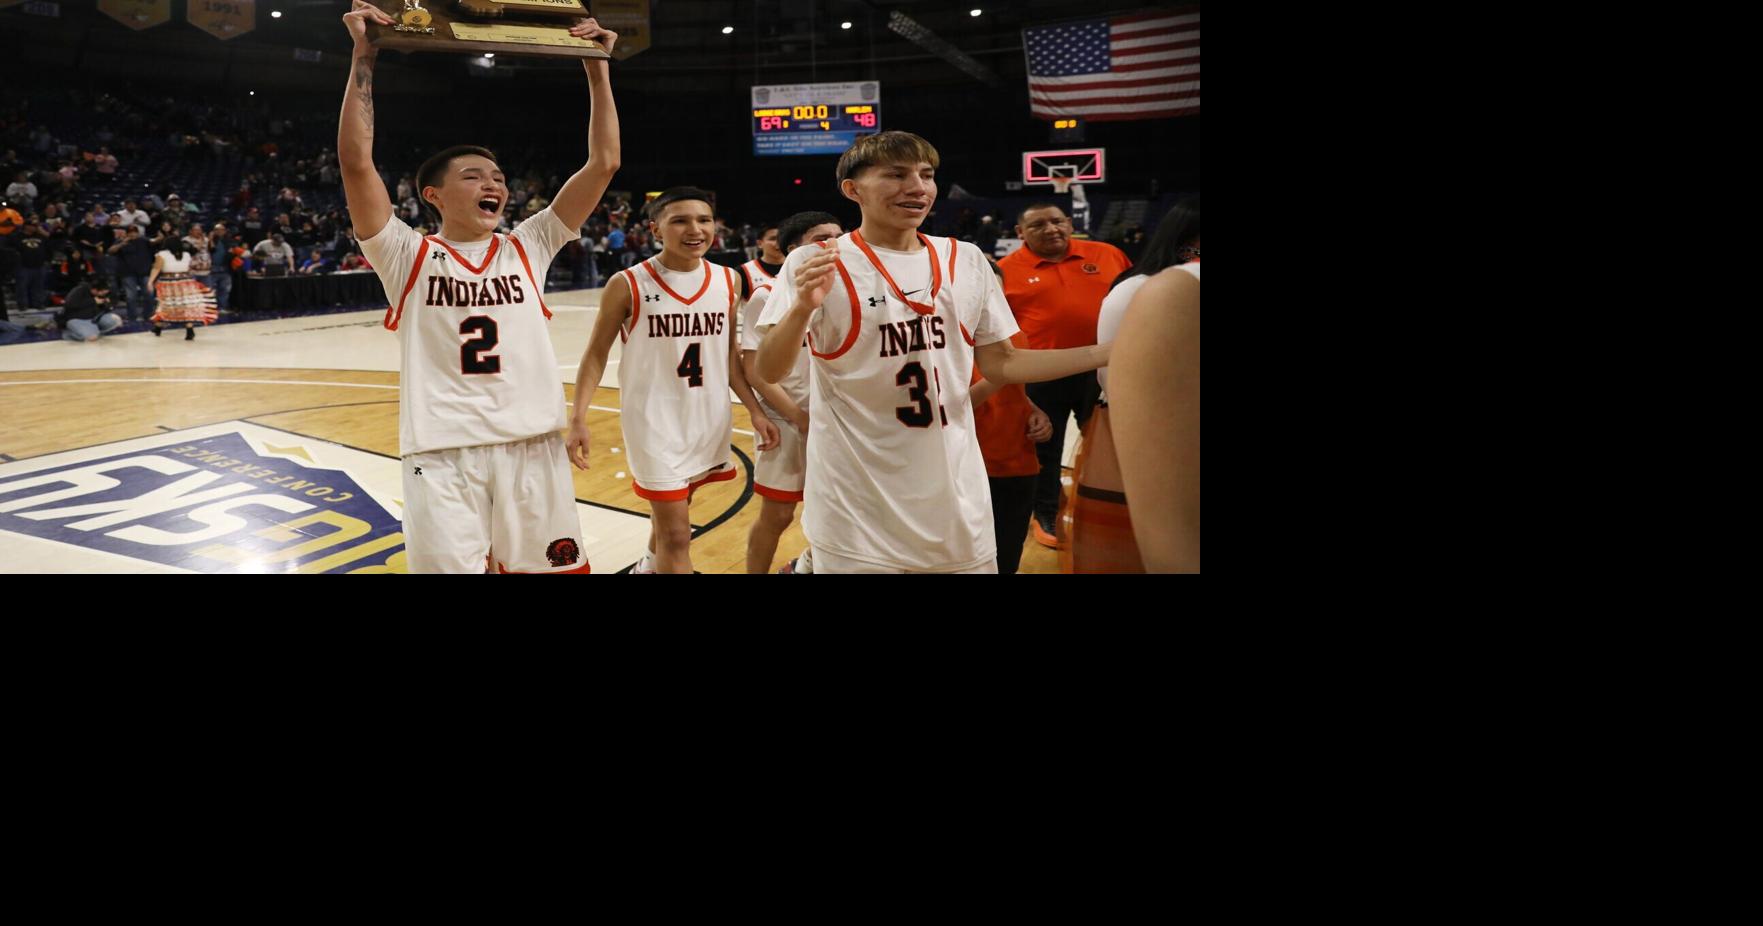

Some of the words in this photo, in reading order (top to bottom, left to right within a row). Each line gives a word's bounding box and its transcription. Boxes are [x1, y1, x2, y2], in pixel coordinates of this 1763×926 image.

[761, 116, 782, 130] 69
[854, 113, 876, 127] 48
[426, 274, 524, 307] INDIANS
[648, 312, 724, 338] INDIANS
[459, 314, 501, 375] 2
[677, 343, 703, 388] 4
[170, 445, 354, 503] CONFERENCE
